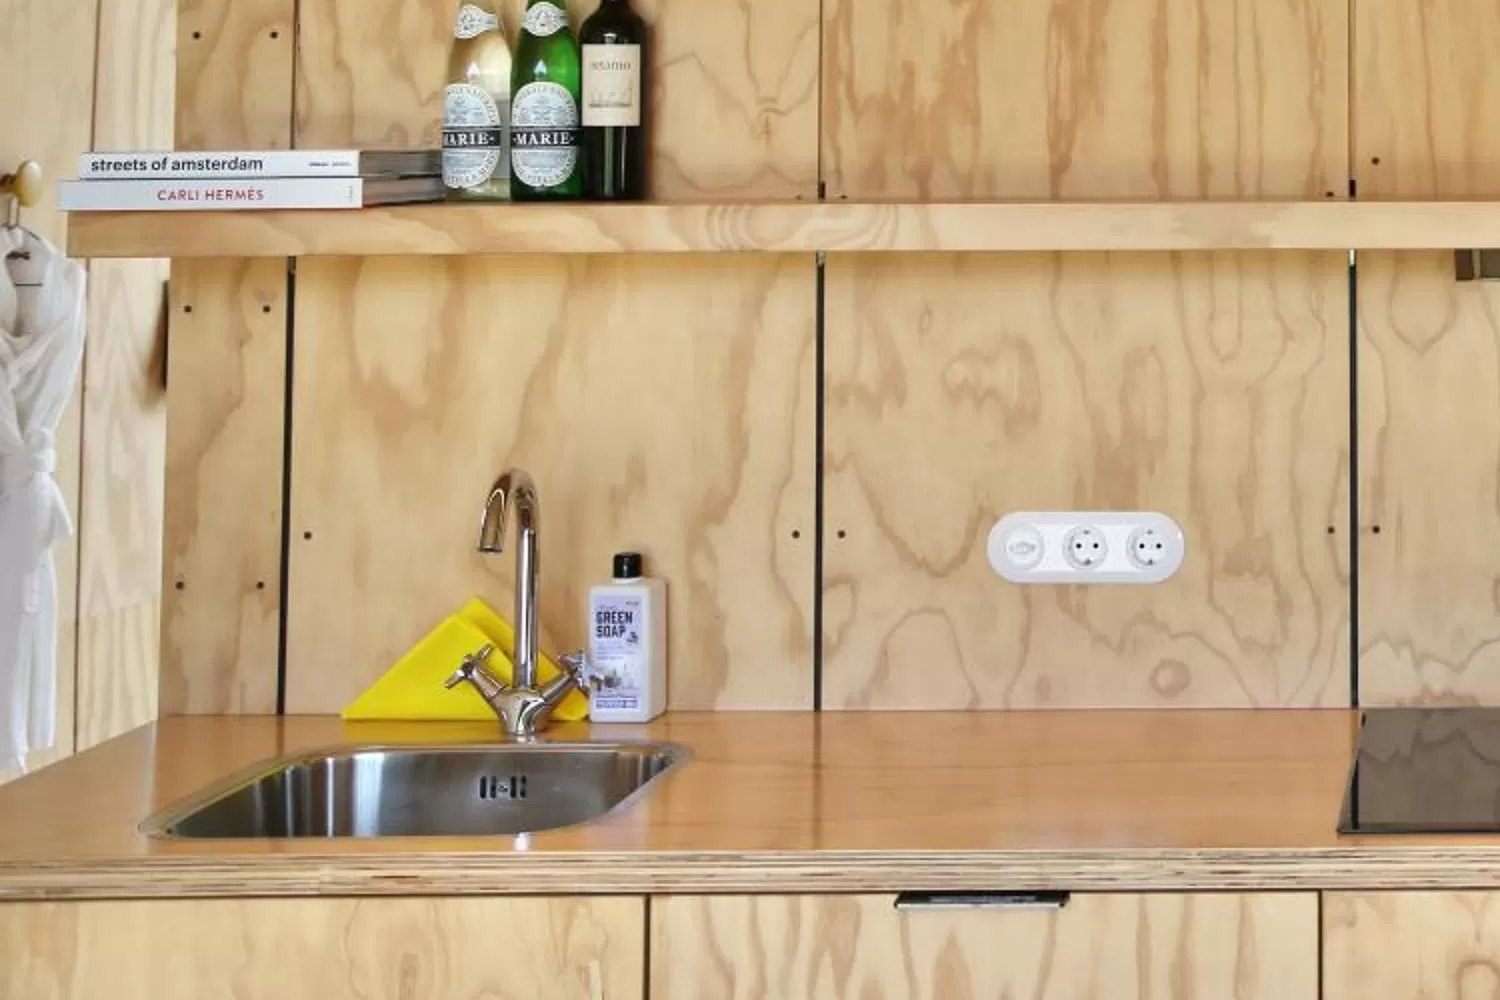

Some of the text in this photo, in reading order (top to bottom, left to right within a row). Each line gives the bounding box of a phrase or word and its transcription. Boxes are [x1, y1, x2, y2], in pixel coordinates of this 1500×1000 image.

[444, 132, 489, 146] ARIE
[516, 132, 570, 146] MARIE
[91, 156, 263, 172] streets of amsterdam
[157, 190, 199, 201] CARLI
[596, 611, 633, 624] GREEN
[596, 625, 626, 638] SOAP
